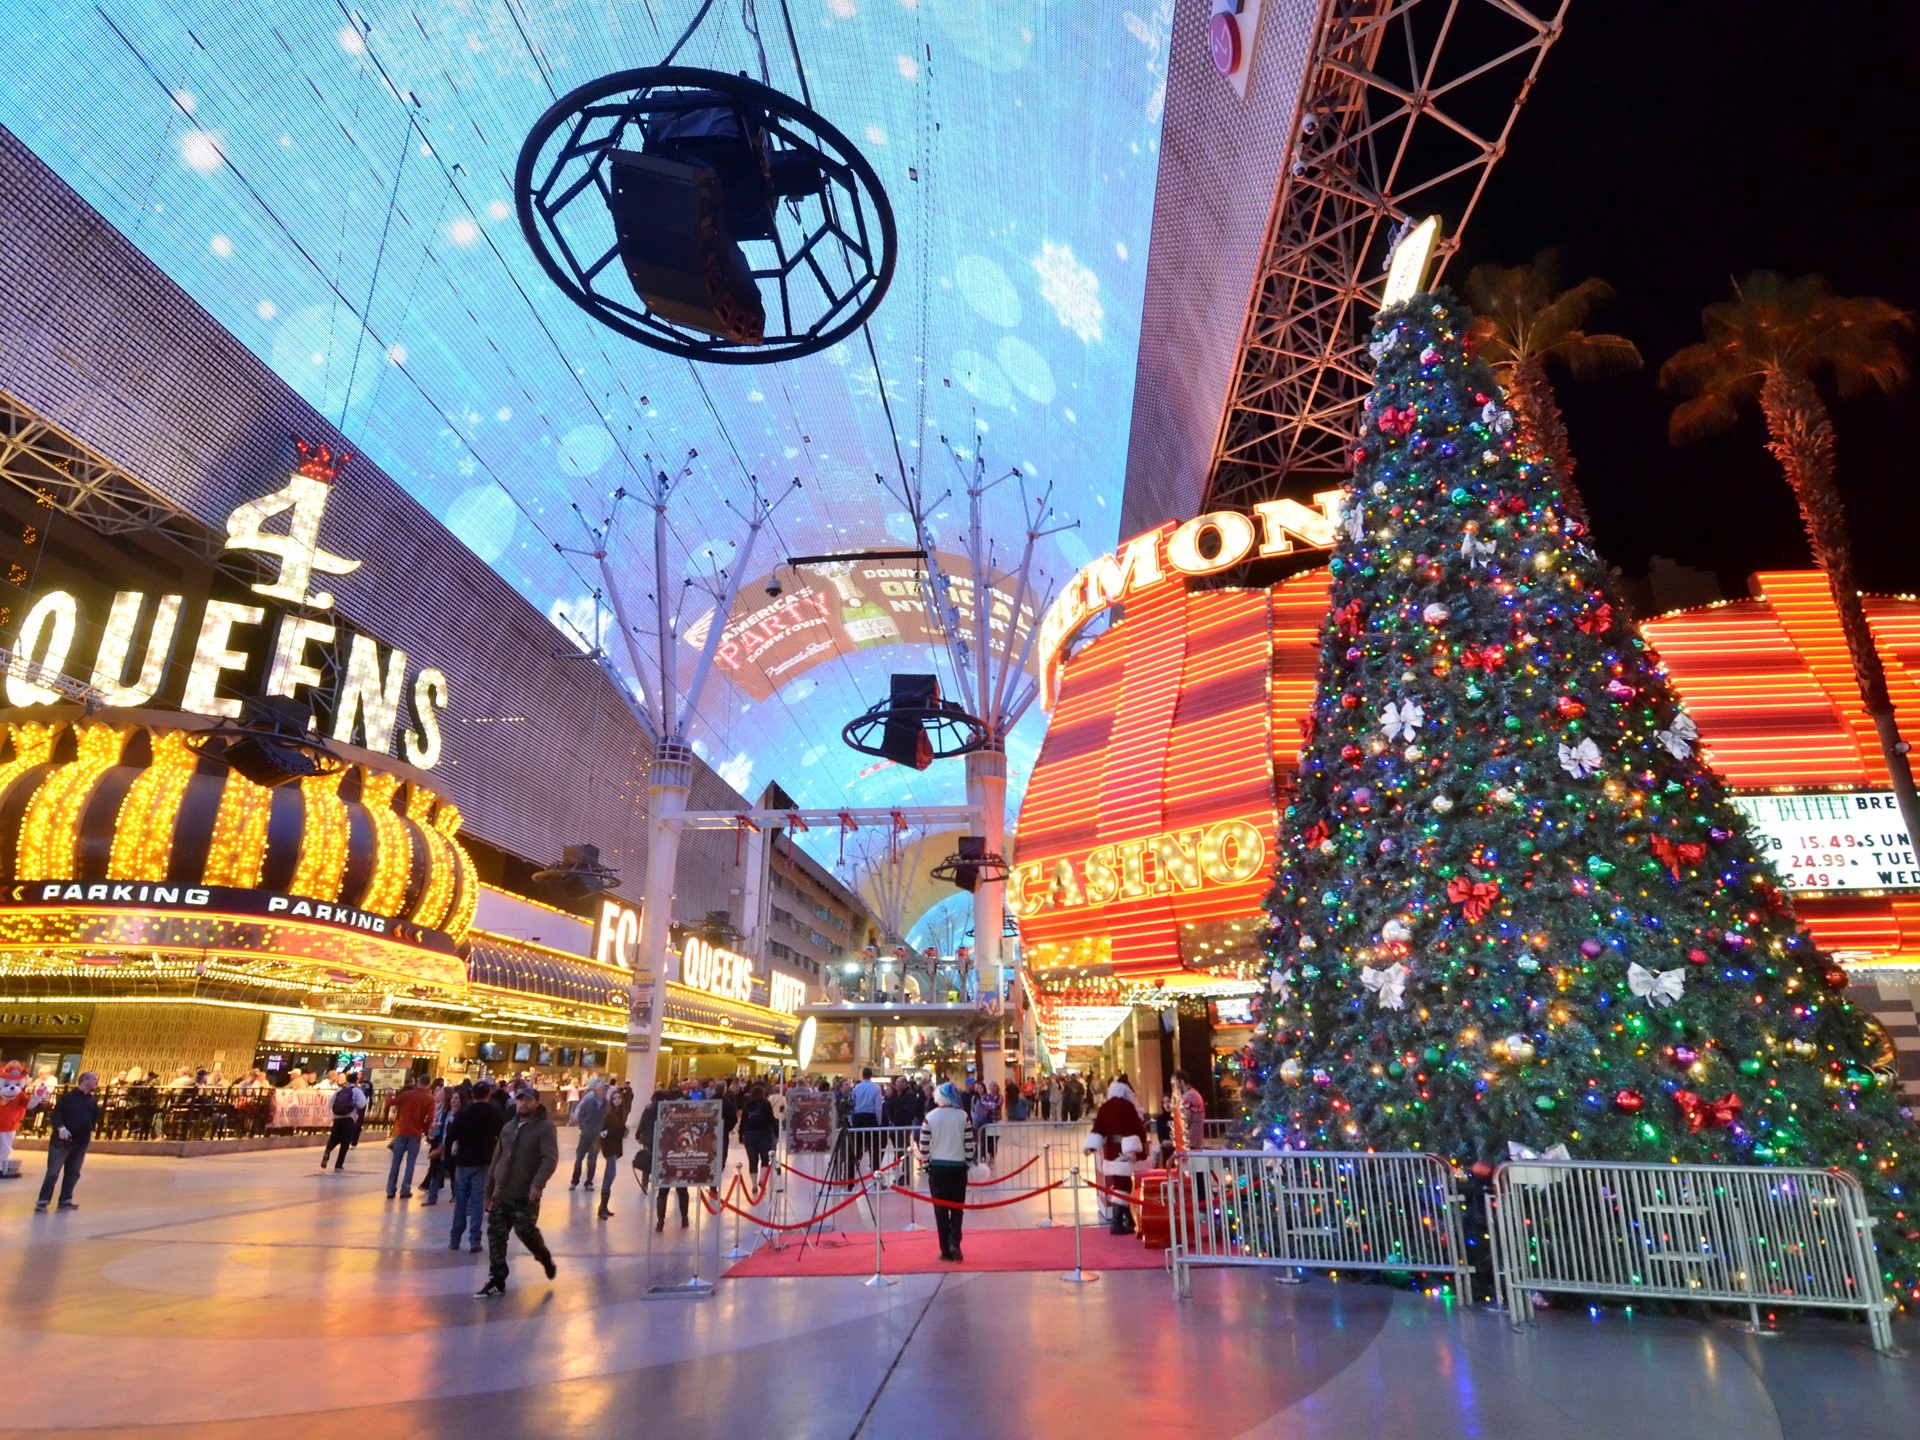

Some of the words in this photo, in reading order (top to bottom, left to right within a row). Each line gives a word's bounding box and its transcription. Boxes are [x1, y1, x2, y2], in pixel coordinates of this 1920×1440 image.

[225, 473, 362, 609] 4
[863, 568, 975, 588] DOWNTWN
[717, 592, 832, 671] PARTY
[722, 585, 813, 643] AMERICA'S
[746, 617, 828, 664] DOWNTOWN
[6, 590, 449, 770] QUEENS
[1770, 795, 1850, 821] BUFFET
[1791, 853, 1846, 867] 24.99
[1871, 852, 1915, 866] TUE
[1800, 834, 1856, 849] 15.49
[1864, 833, 1910, 847] SUN
[1005, 820, 1265, 918] CASINO
[1877, 870, 1920, 884] WED
[43, 885, 210, 905] PARKING
[268, 896, 386, 932] PARKING
[684, 936, 753, 1002] QUEENS
[297, 1093, 330, 1106] WELCO
[666, 1150, 686, 1158] Santa
